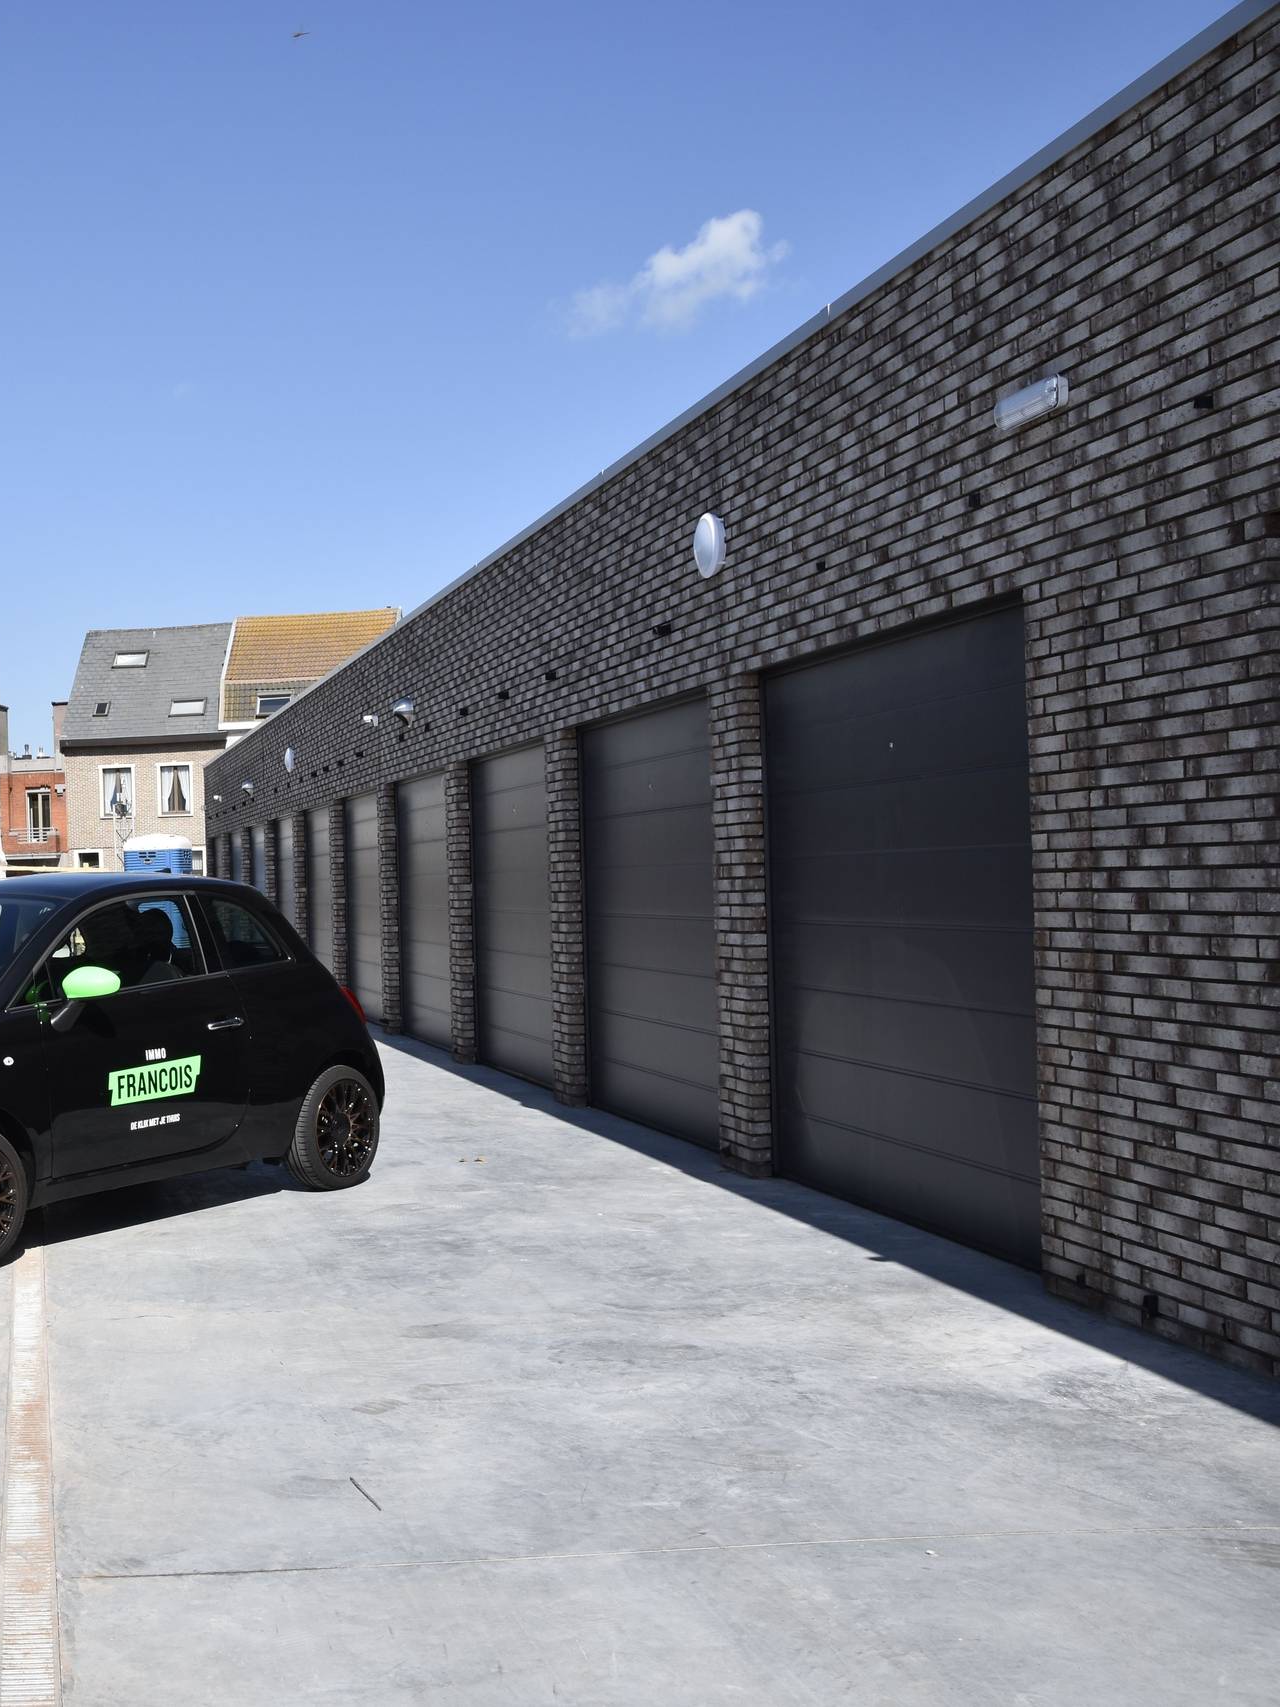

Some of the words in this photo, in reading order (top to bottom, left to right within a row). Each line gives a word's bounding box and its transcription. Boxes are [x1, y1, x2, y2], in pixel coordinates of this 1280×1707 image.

[145, 1048, 167, 1061] IMMO
[117, 1064, 193, 1100] FRANCOIS
[130, 1121, 137, 1130] DE
[149, 1117, 159, 1126] MET
[159, 1116, 166, 1125] JE
